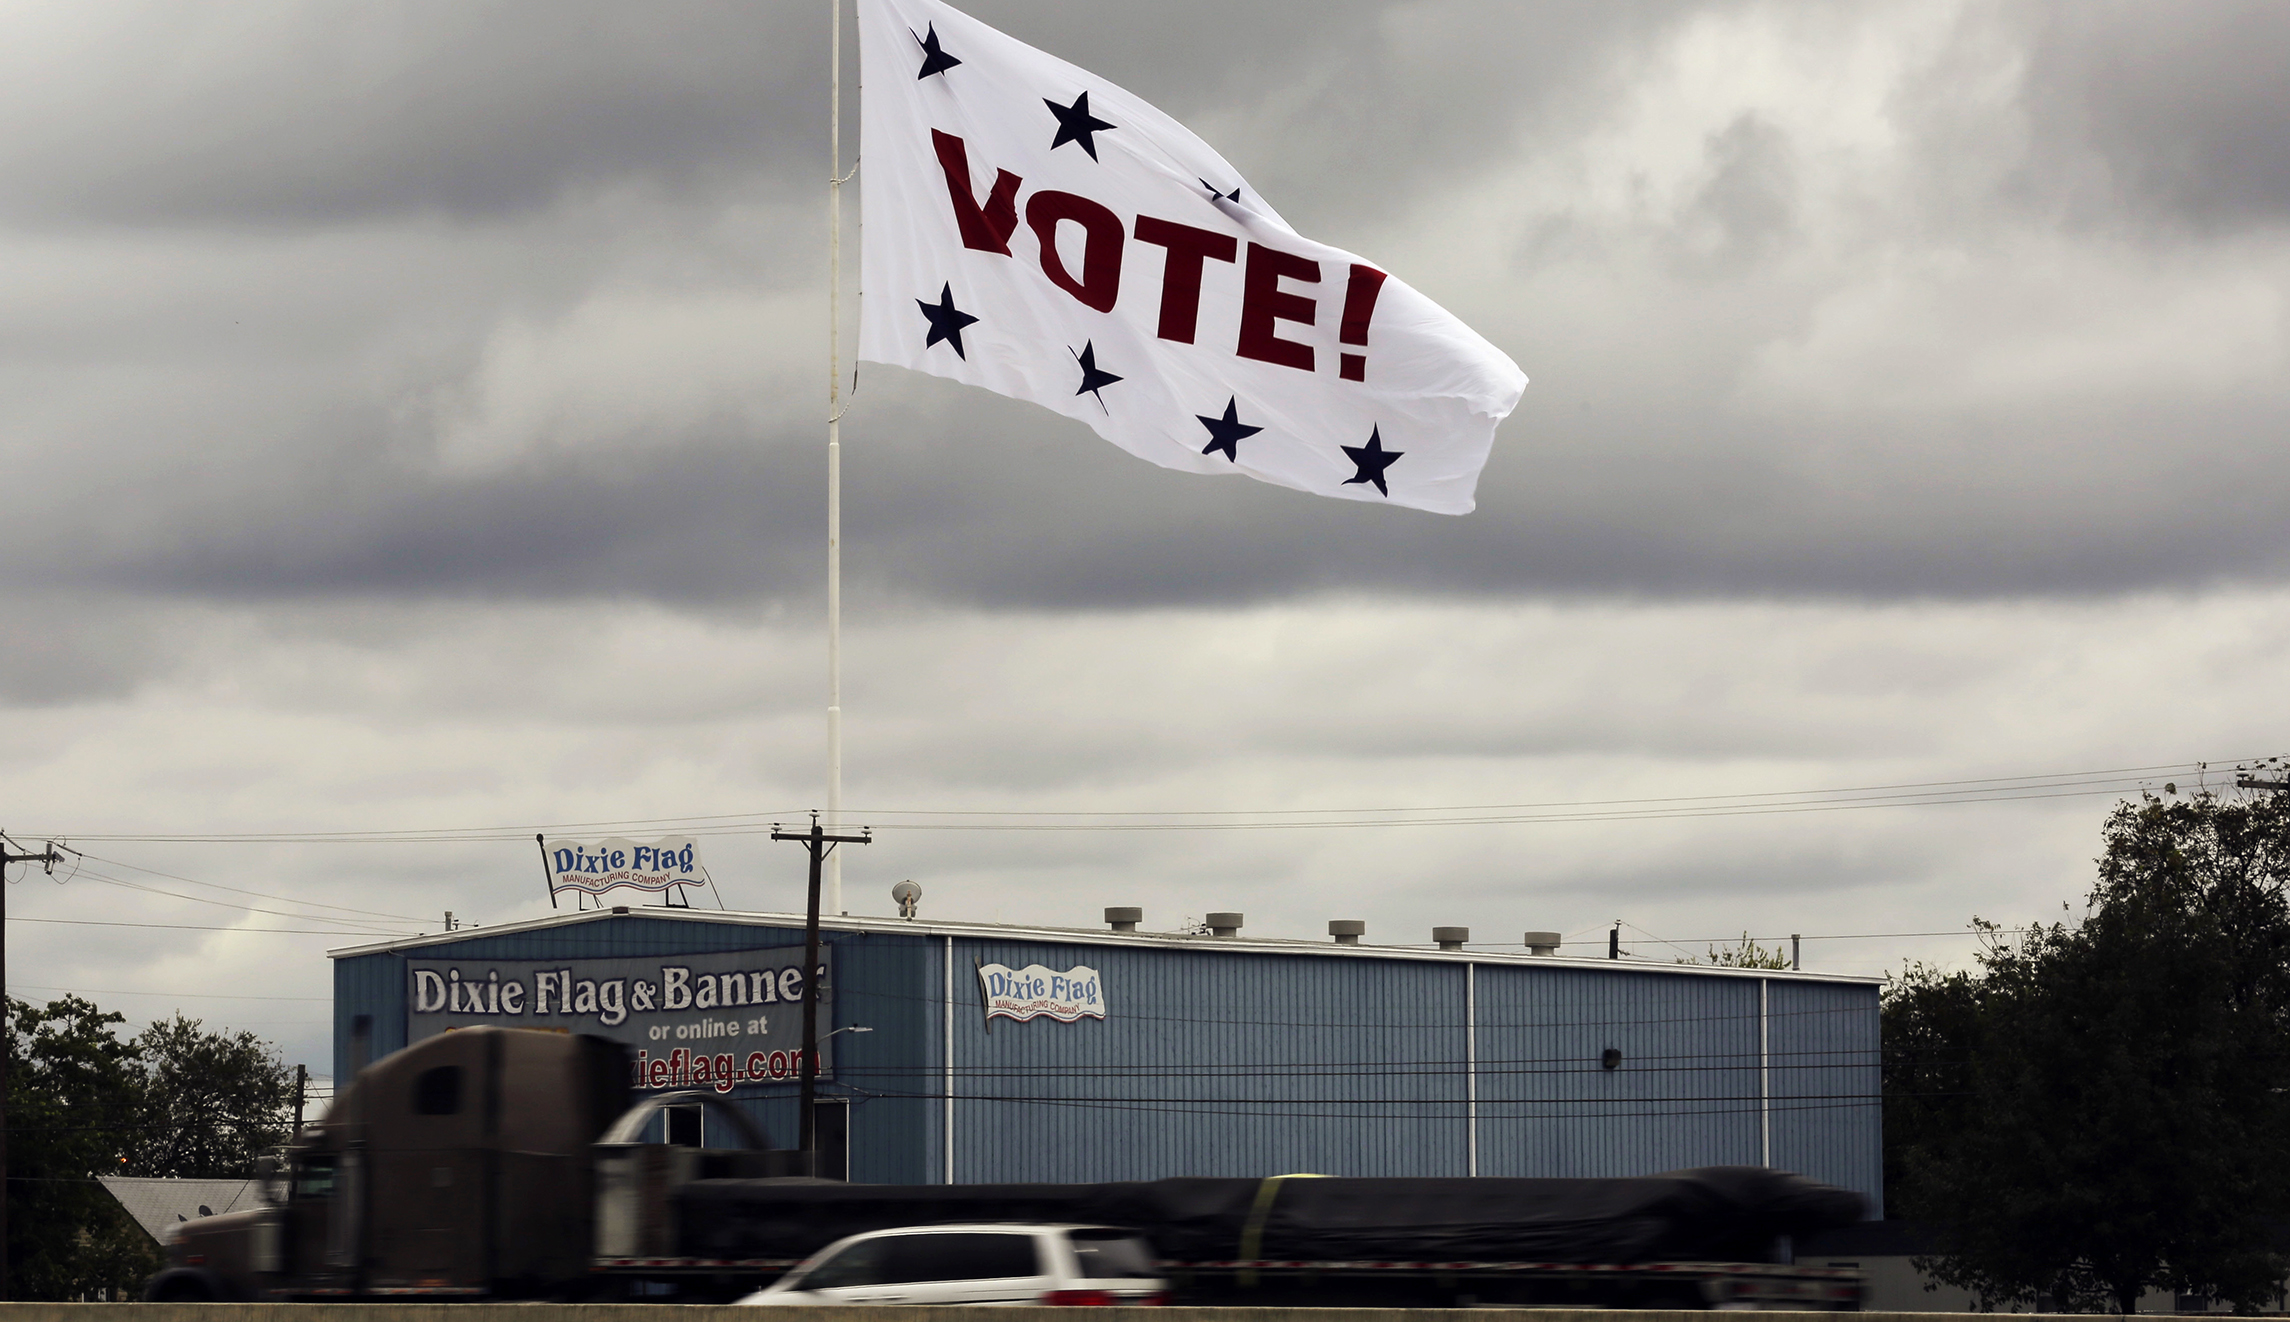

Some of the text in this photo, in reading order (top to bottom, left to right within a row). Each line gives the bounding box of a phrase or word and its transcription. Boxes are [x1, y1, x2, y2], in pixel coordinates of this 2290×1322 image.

[931, 127, 1387, 382] VOTE!
[553, 843, 694, 874] Dixie Flag
[562, 871, 671, 888] MANUFACTURING COMPANY
[414, 969, 525, 1014] Dixie
[535, 969, 627, 1026] Flag
[631, 981, 657, 1010] &
[988, 971, 1097, 1005] Dixie Flag
[995, 1000, 1081, 1015] MANUFACTURING COMPANY
[649, 1015, 768, 1040] or online at
[629, 1047, 822, 1094] ieflag.com
